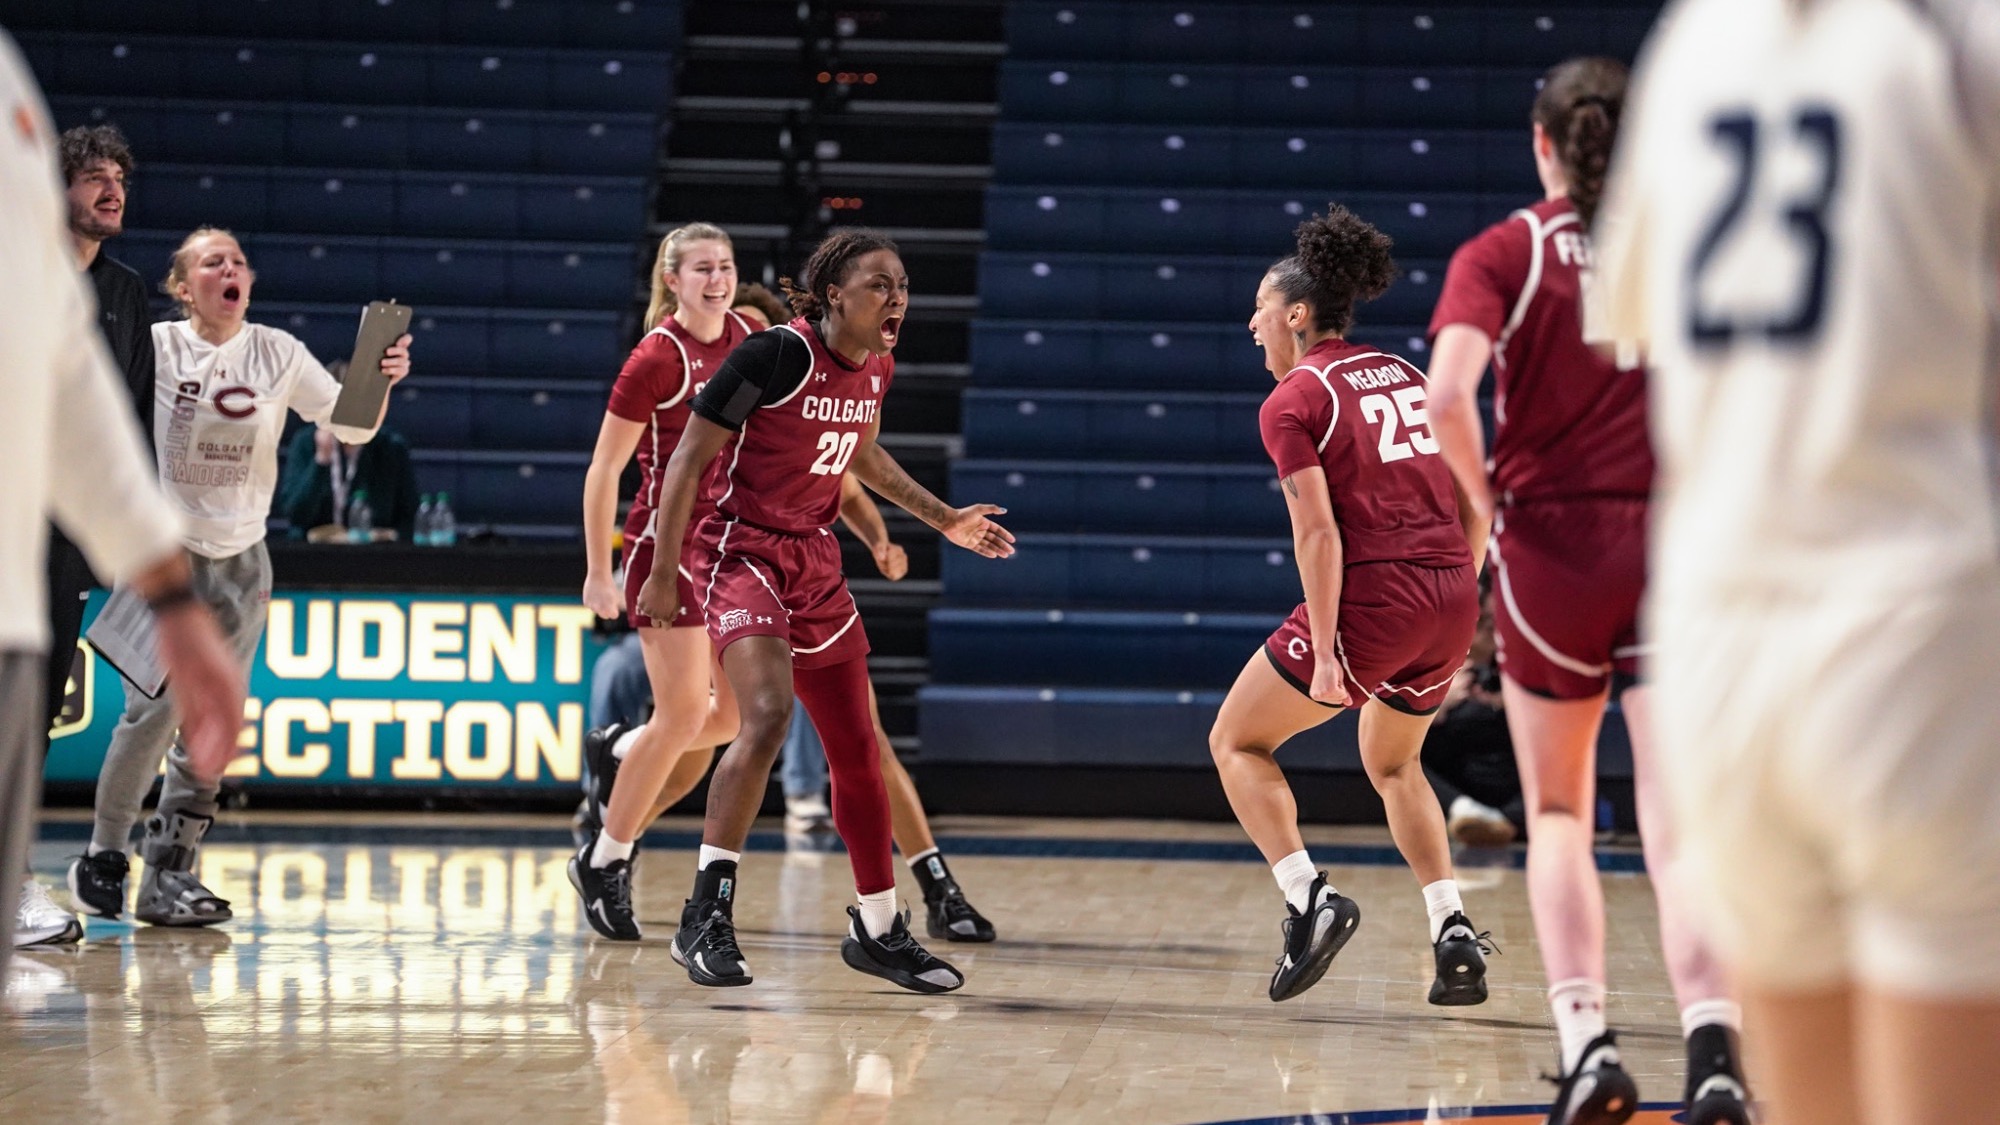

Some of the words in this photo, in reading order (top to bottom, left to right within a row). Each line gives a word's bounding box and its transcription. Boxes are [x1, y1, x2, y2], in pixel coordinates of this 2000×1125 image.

[1686, 107, 1840, 346] 23
[213, 386, 256, 418] C
[1359, 385, 1440, 464] 25
[164, 460, 249, 487] RAIDERS
[197, 442, 253, 455] COLGATE
[809, 431, 859, 475] 20
[266, 598, 595, 684] UDENT
[225, 697, 584, 781] ECTION
